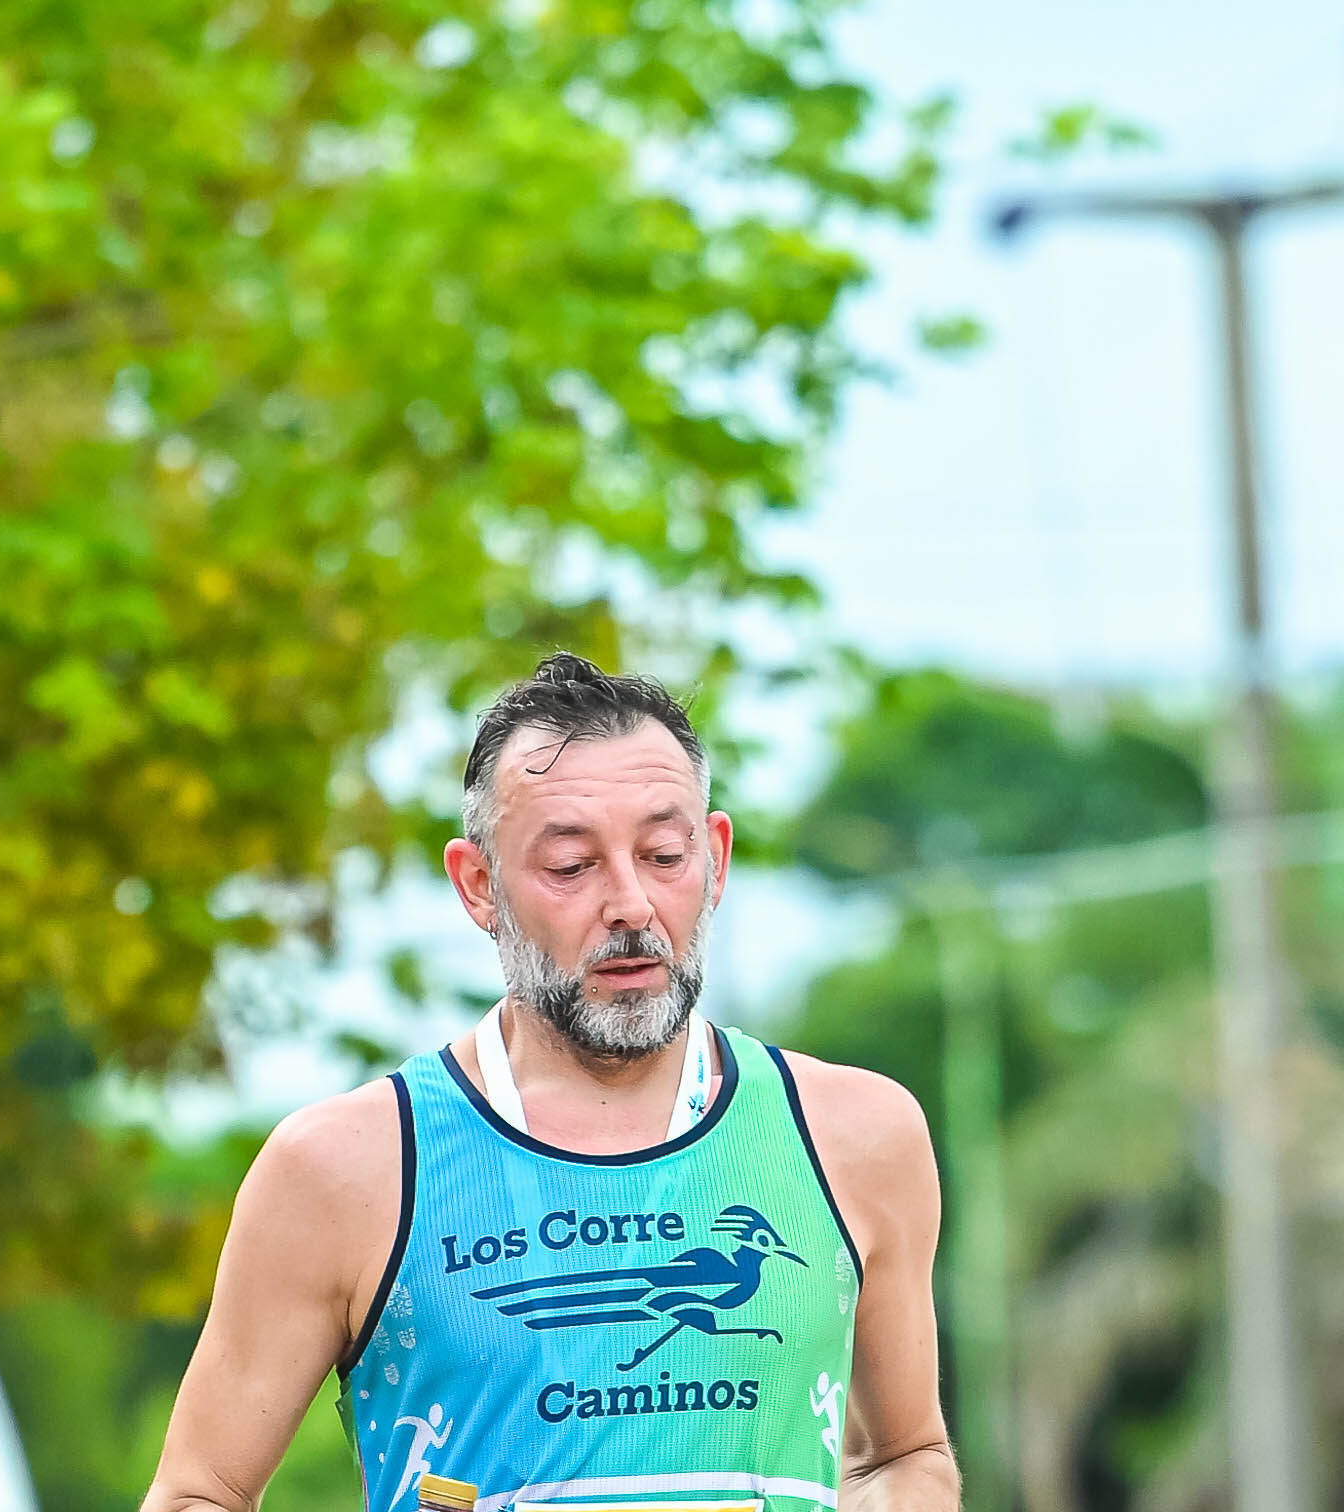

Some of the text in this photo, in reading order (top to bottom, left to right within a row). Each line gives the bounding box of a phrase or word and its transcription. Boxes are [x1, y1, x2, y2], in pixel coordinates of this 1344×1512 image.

[441, 1209, 685, 1273] Los Corre
[536, 1371, 760, 1423] Caminos
